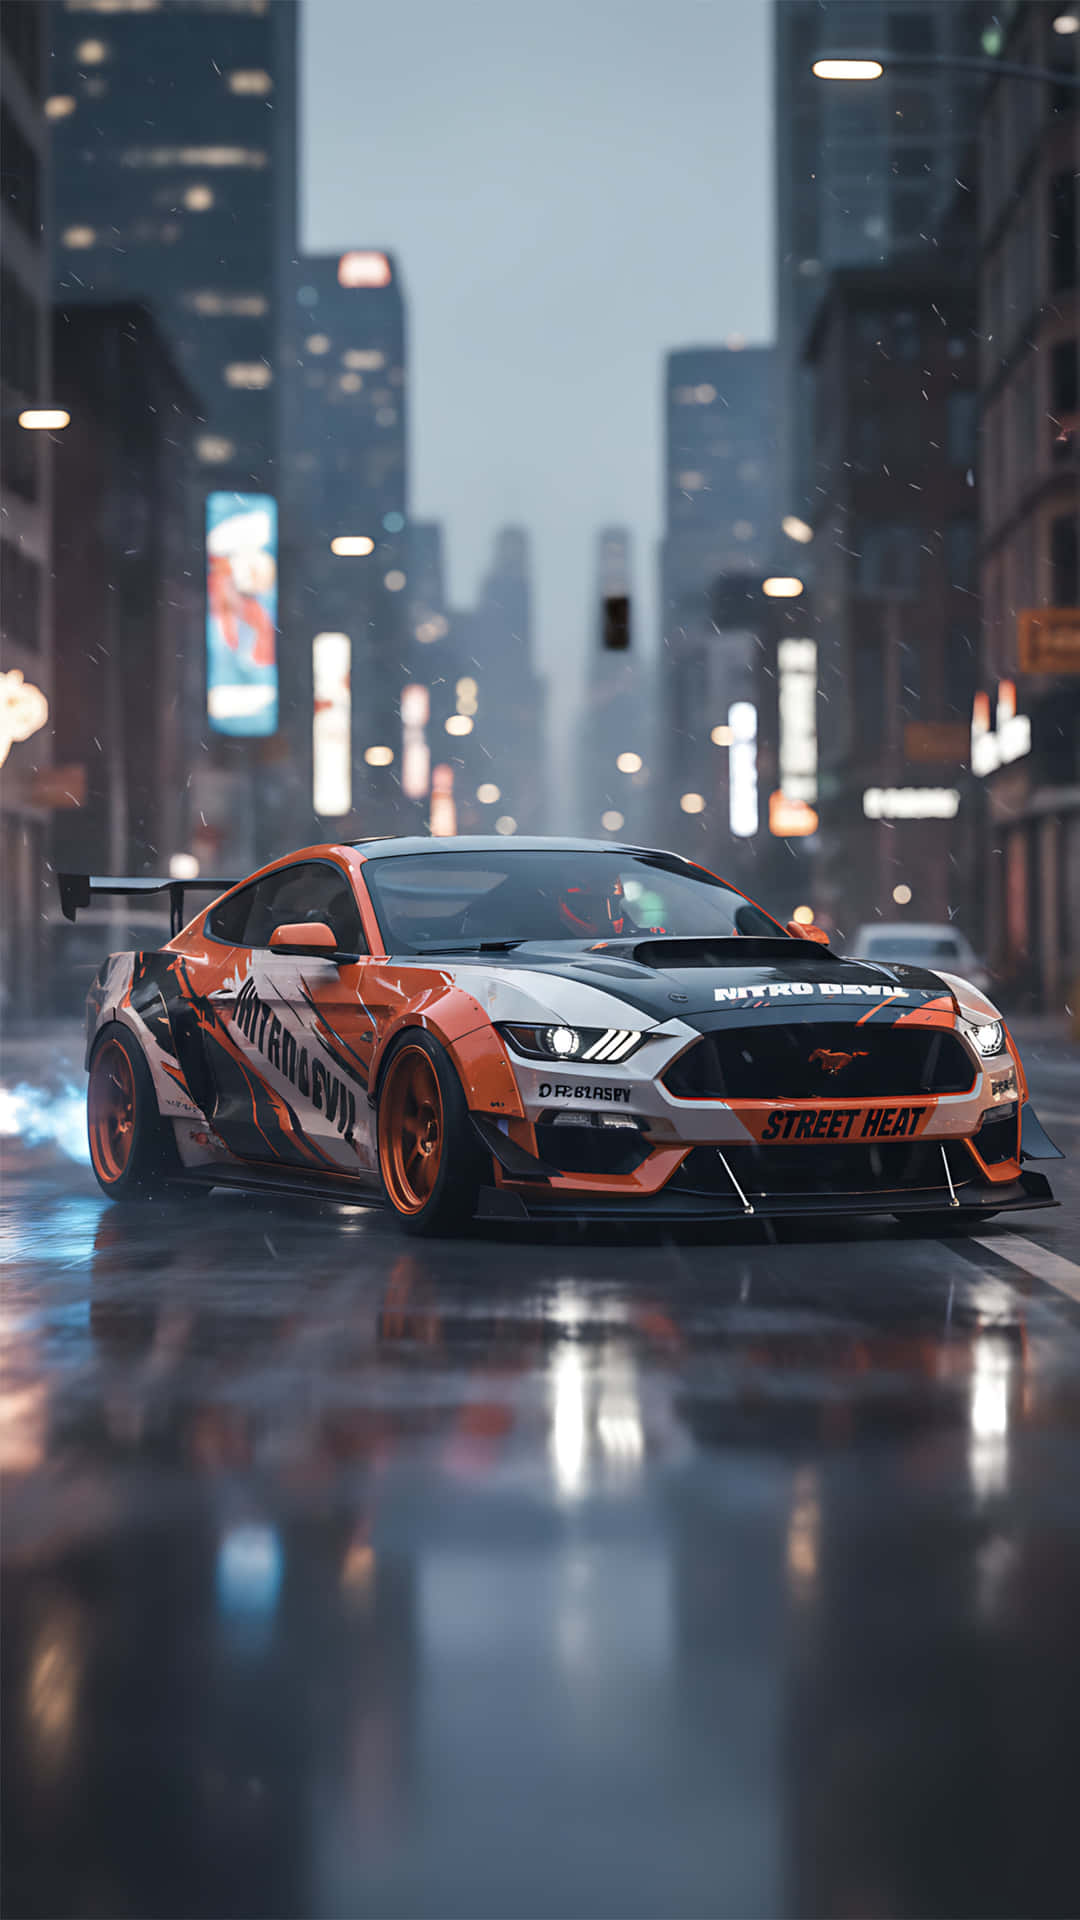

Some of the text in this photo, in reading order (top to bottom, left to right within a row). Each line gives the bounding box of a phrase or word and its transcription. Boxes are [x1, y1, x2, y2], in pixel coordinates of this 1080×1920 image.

[714, 982, 910, 1001] NITRO DEVIL
[761, 1107, 927, 1140] STREET HEAT
